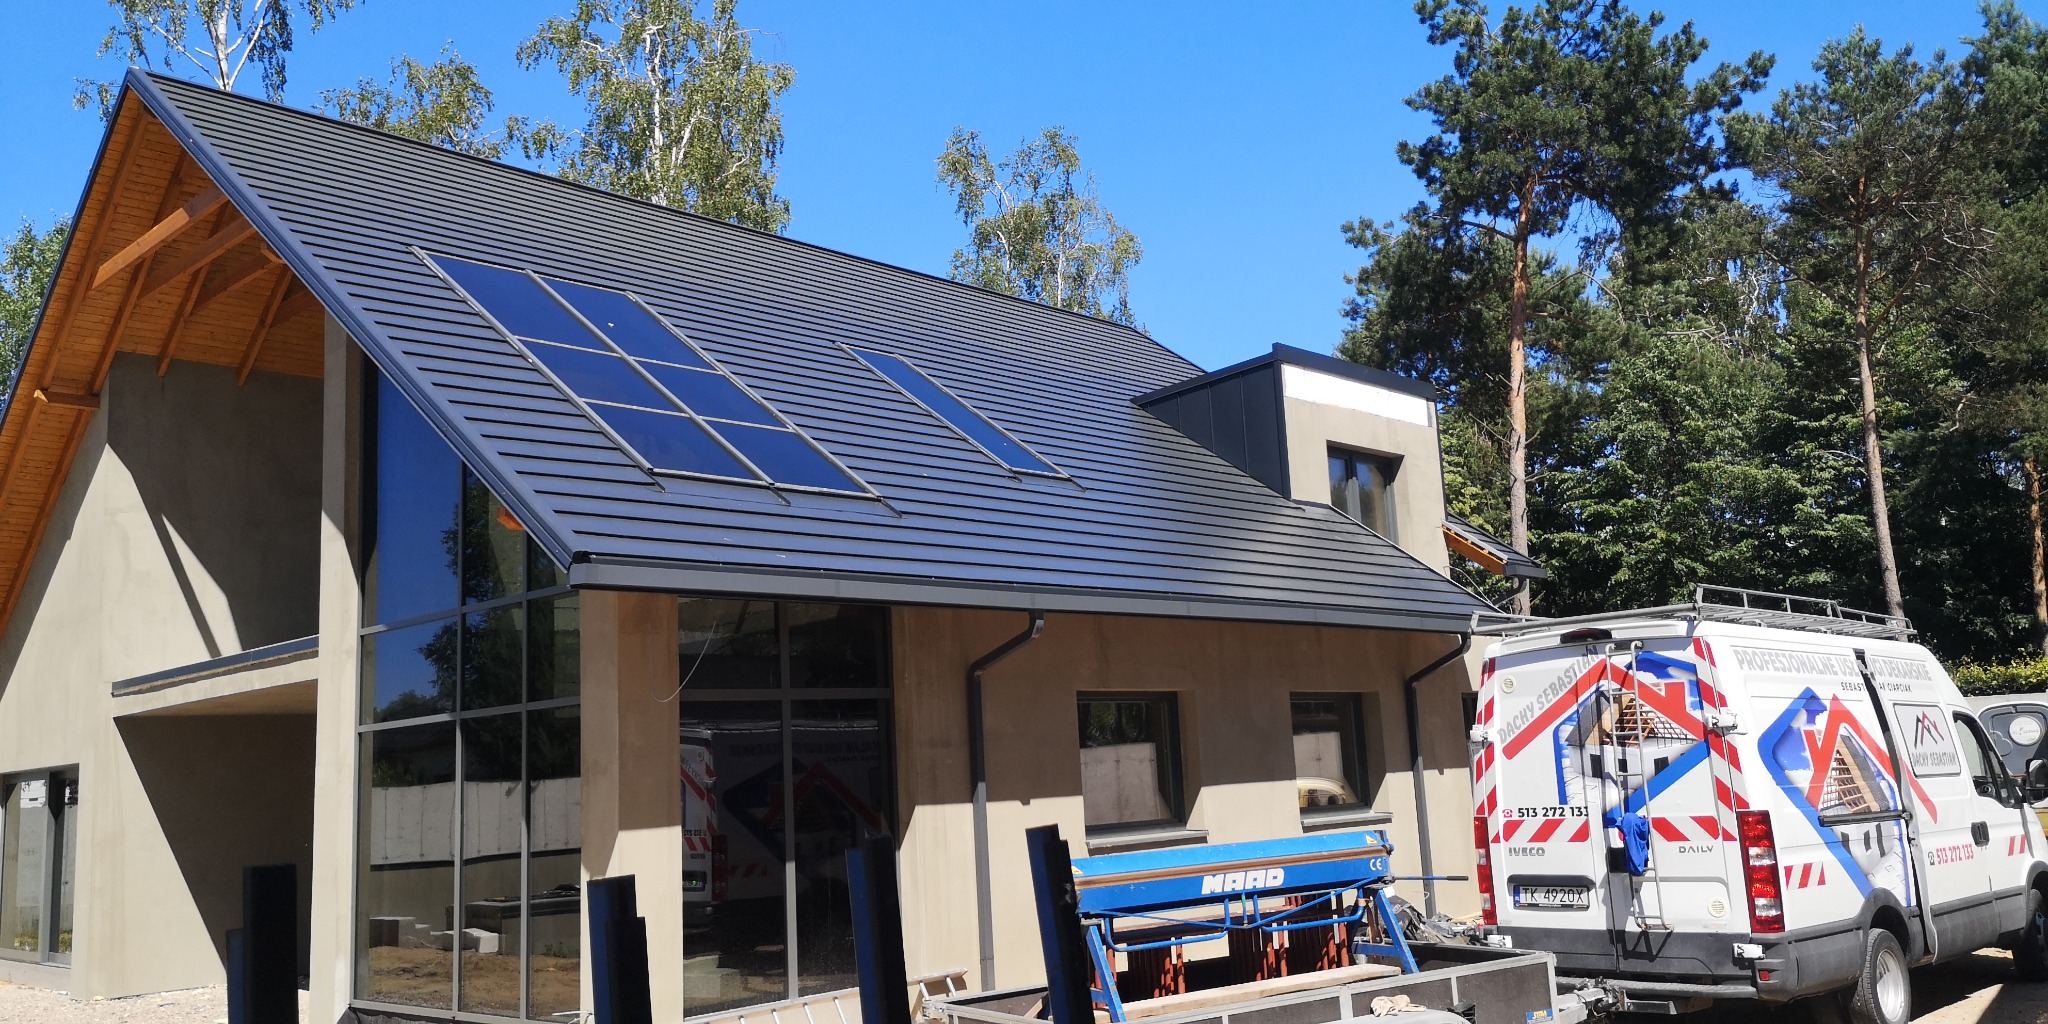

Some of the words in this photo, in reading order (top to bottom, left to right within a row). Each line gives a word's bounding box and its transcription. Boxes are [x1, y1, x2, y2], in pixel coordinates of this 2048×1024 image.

[1732, 649, 1839, 676] PROFESJONALNE
[1882, 658, 1933, 681] DEKARSKIE
[1497, 702, 1536, 745] DACHY
[1536, 644, 1601, 711] SEBASTIAN
[1911, 751, 1929, 768] DACHY
[1929, 751, 1957, 768] SEBASTIAN
[1518, 807, 1538, 818] 513
[1542, 806, 1566, 818] 272
[1508, 846, 1546, 857] IVECO
[1678, 845, 1714, 854] DAILY
[1936, 847, 1949, 865] 513
[1948, 845, 1963, 863] 272
[1962, 843, 1974, 861] 133
[1369, 858, 1383, 871] CE
[1201, 868, 1285, 895] MAAD
[1522, 887, 1538, 902] TK
[1543, 888, 1584, 904] 4920X
